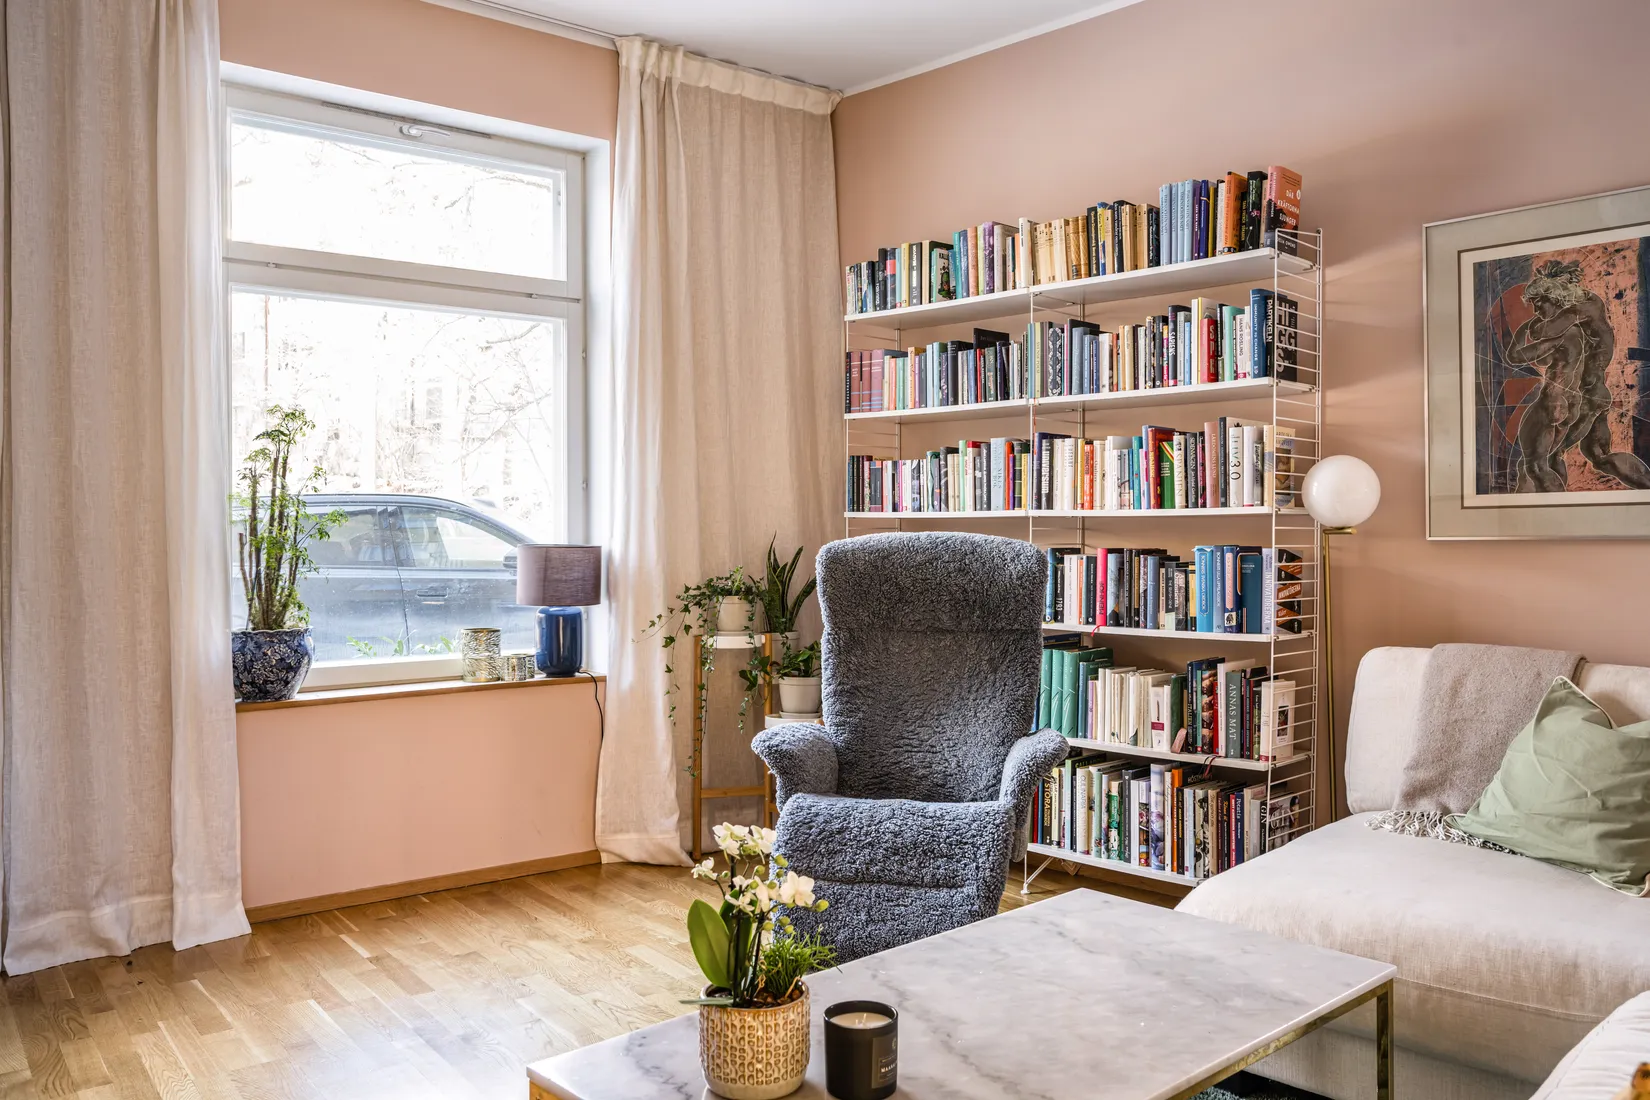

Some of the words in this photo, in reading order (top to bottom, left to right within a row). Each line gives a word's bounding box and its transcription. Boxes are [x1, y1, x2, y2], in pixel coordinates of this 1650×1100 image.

[1042, 451, 1050, 494] universum
[1229, 684, 1237, 716] ANNAS
[1229, 718, 1237, 741] MAT
